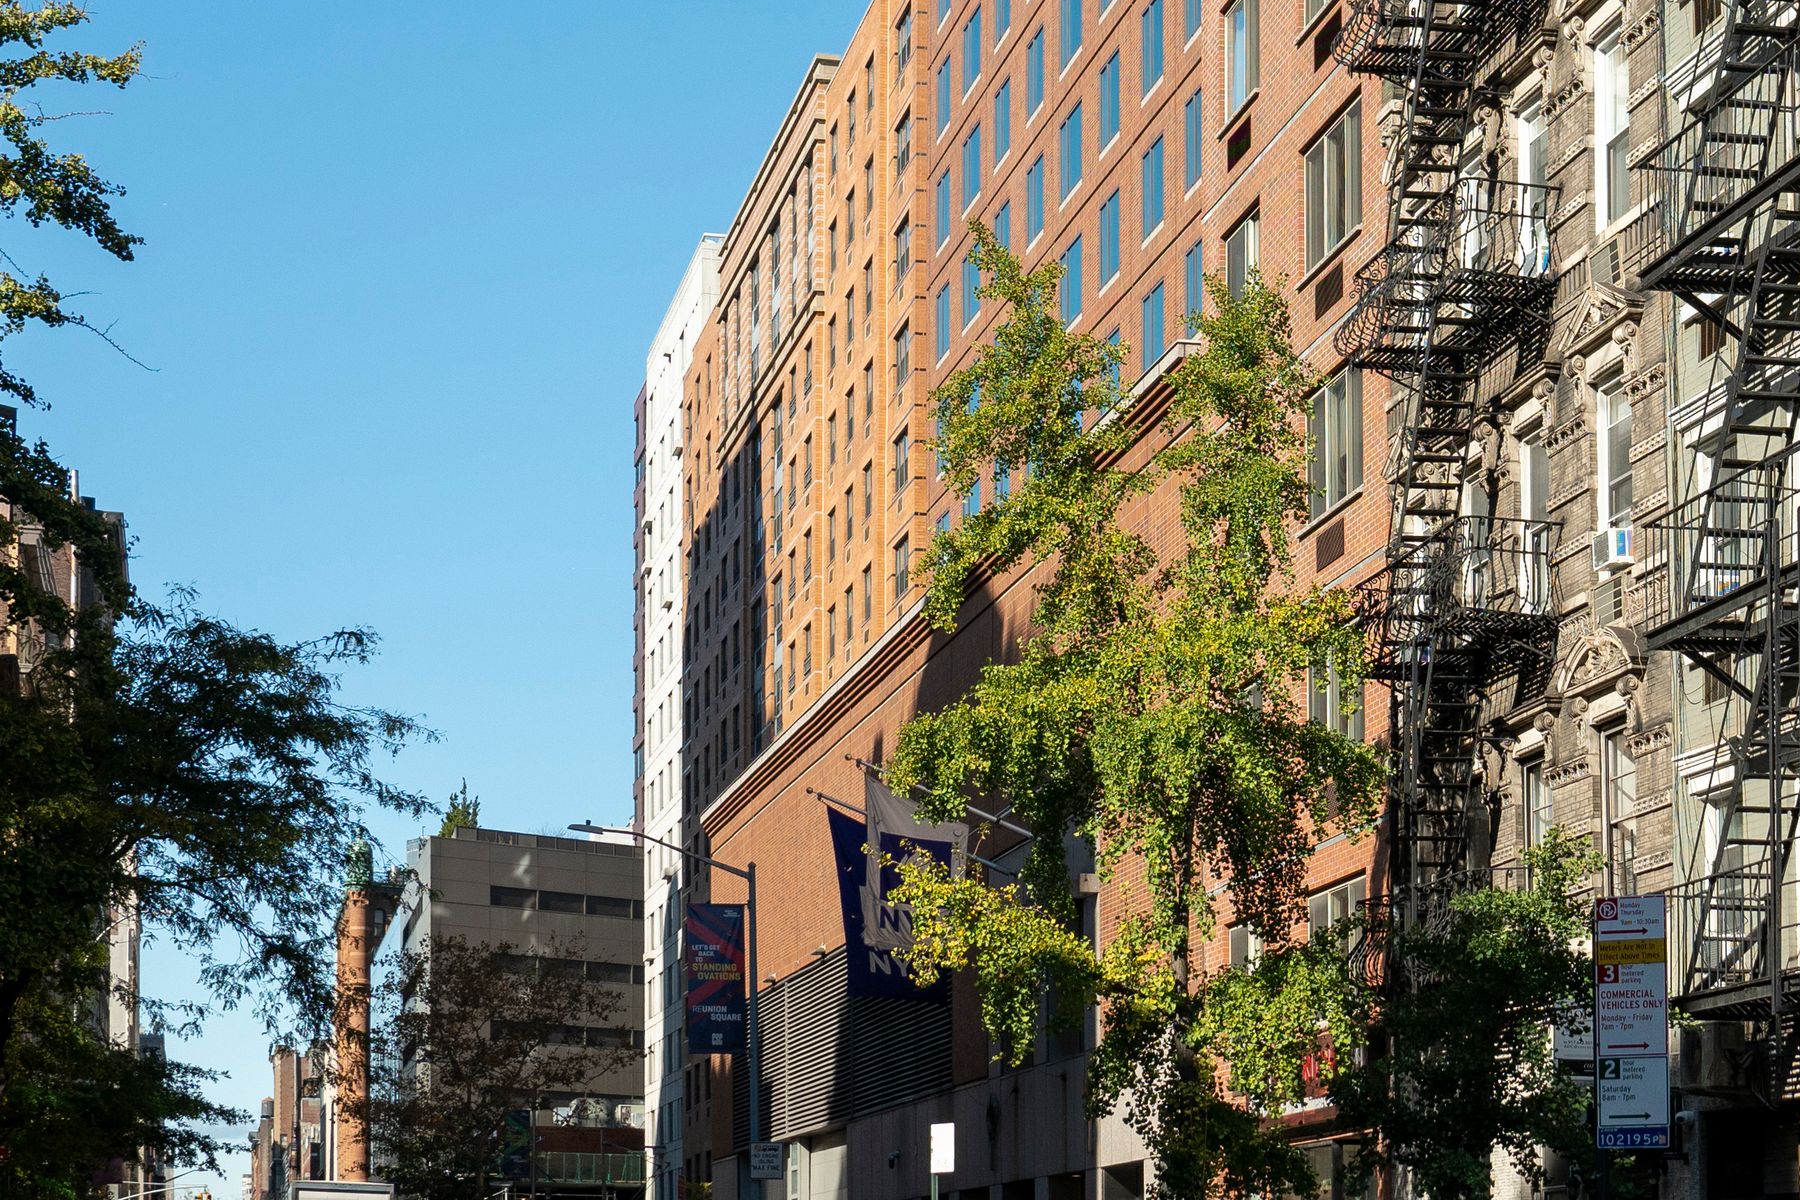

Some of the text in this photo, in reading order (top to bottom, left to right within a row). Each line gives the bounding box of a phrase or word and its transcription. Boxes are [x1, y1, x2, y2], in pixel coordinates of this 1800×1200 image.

[1620, 952, 1640, 960] Above
[1642, 951, 1660, 959] Times
[692, 962, 737, 972] STANDING
[697, 972, 741, 980] OVATIONS
[1603, 964, 1615, 982] 3
[1600, 989, 1655, 1000] COMMERCIAL
[692, 1004, 727, 1013] REUNION
[1601, 999, 1664, 1010] VEHICLES ONLY
[710, 1013, 742, 1022] SQUARE
[1601, 1014, 1627, 1022] Monday
[1632, 1013, 1653, 1021] Friday
[1620, 1023, 1634, 1031] 7pm
[1604, 1060, 1616, 1078] 2
[1602, 1085, 1632, 1093] Saturday
[1623, 1094, 1636, 1102] 7pm
